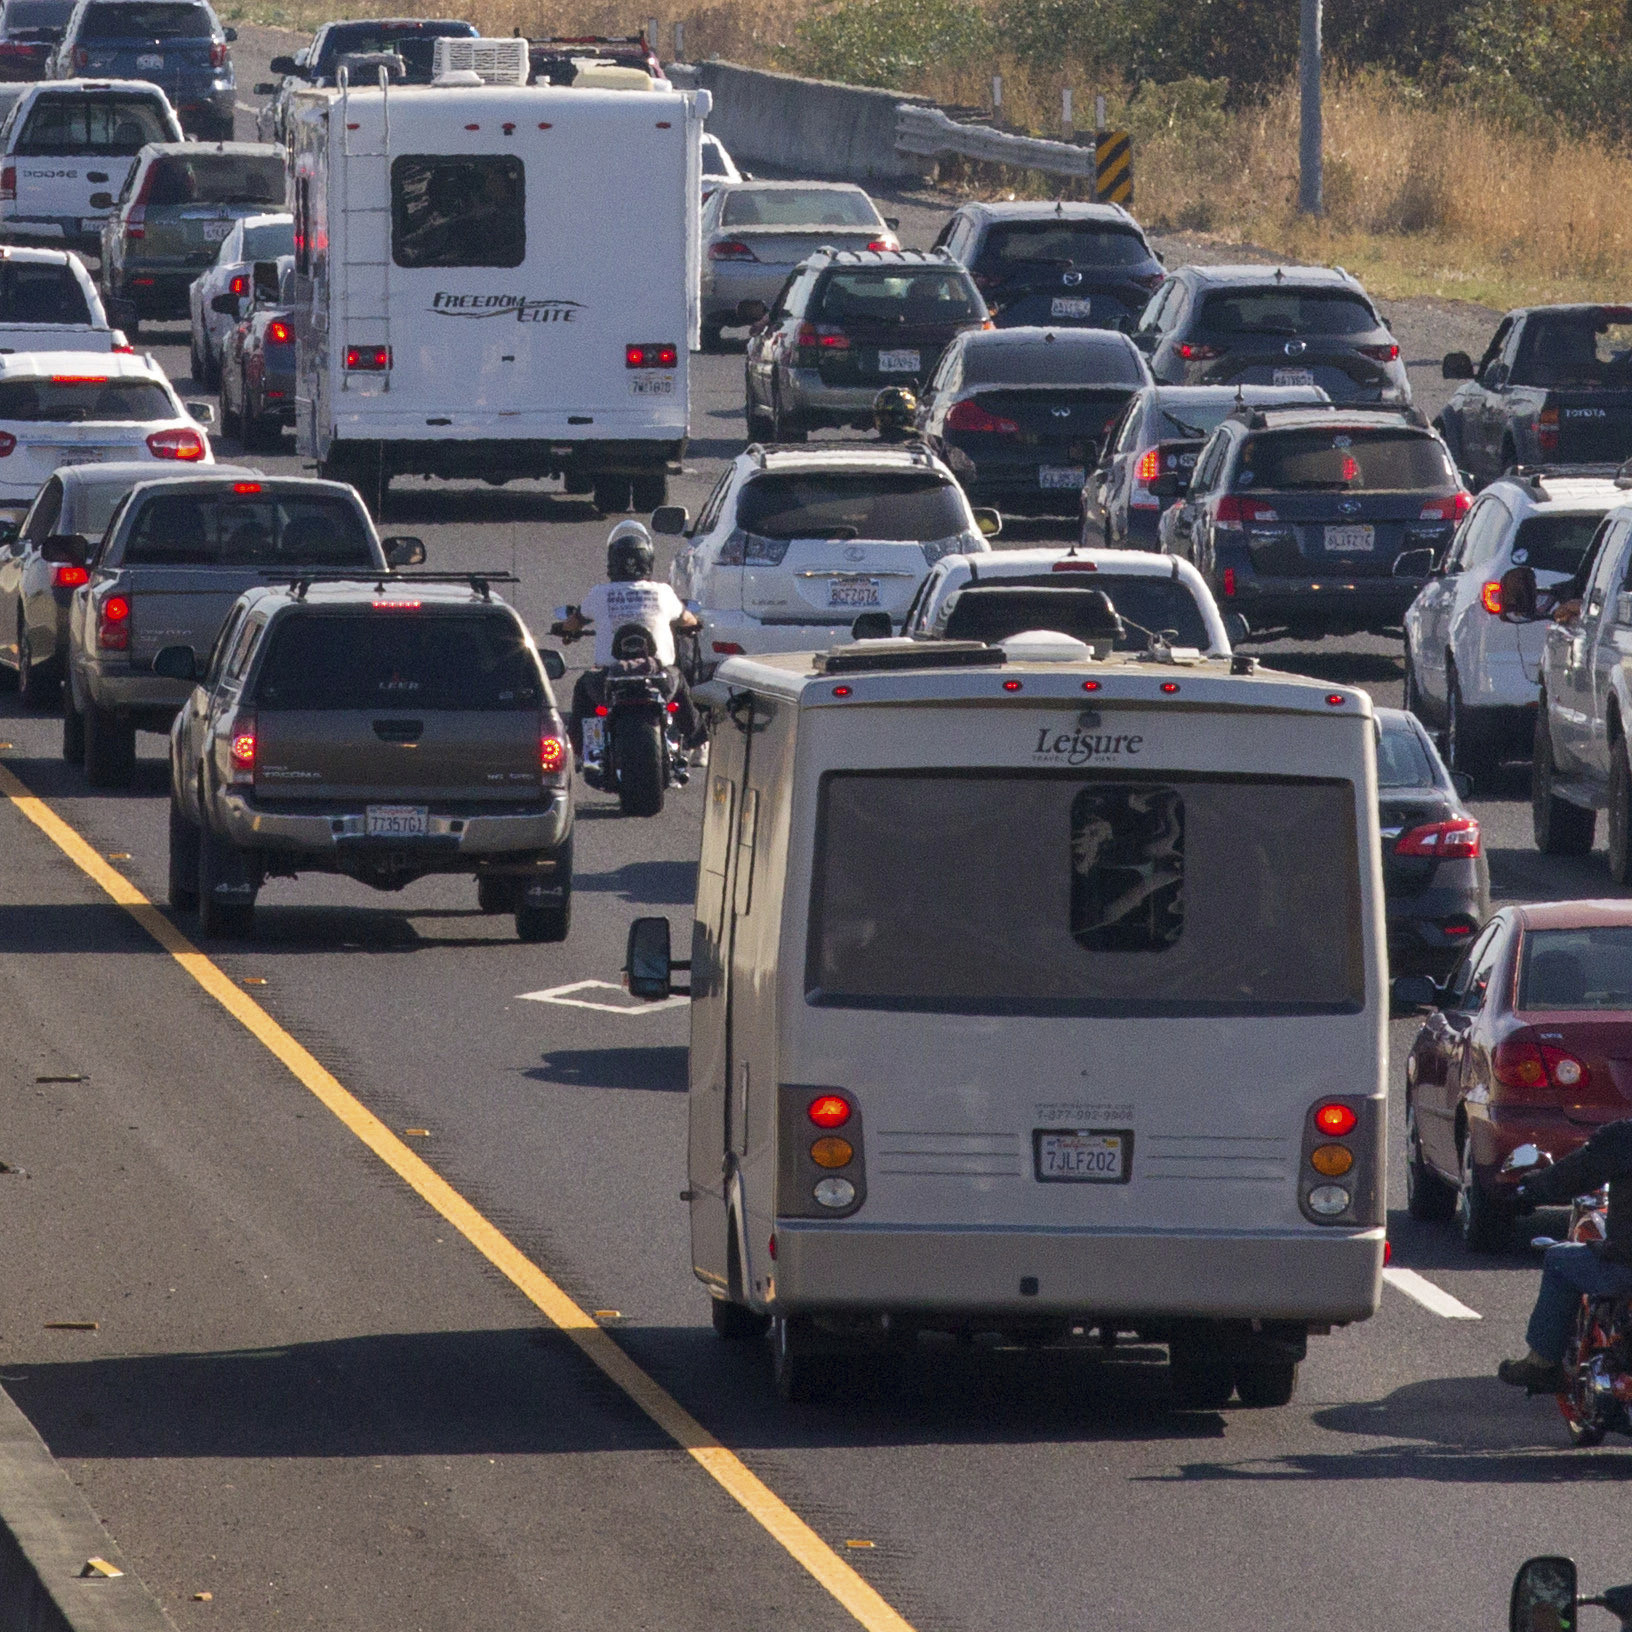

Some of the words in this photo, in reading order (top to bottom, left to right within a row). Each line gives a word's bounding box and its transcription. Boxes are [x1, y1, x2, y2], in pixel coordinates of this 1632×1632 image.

[432, 291, 526, 308] FREEDOM
[517, 306, 577, 323] ELITE
[1566, 408, 1607, 417] TOYOTA
[1034, 728, 1143, 765] Leisure
[1046, 1151, 1116, 1172] 7JLF202
